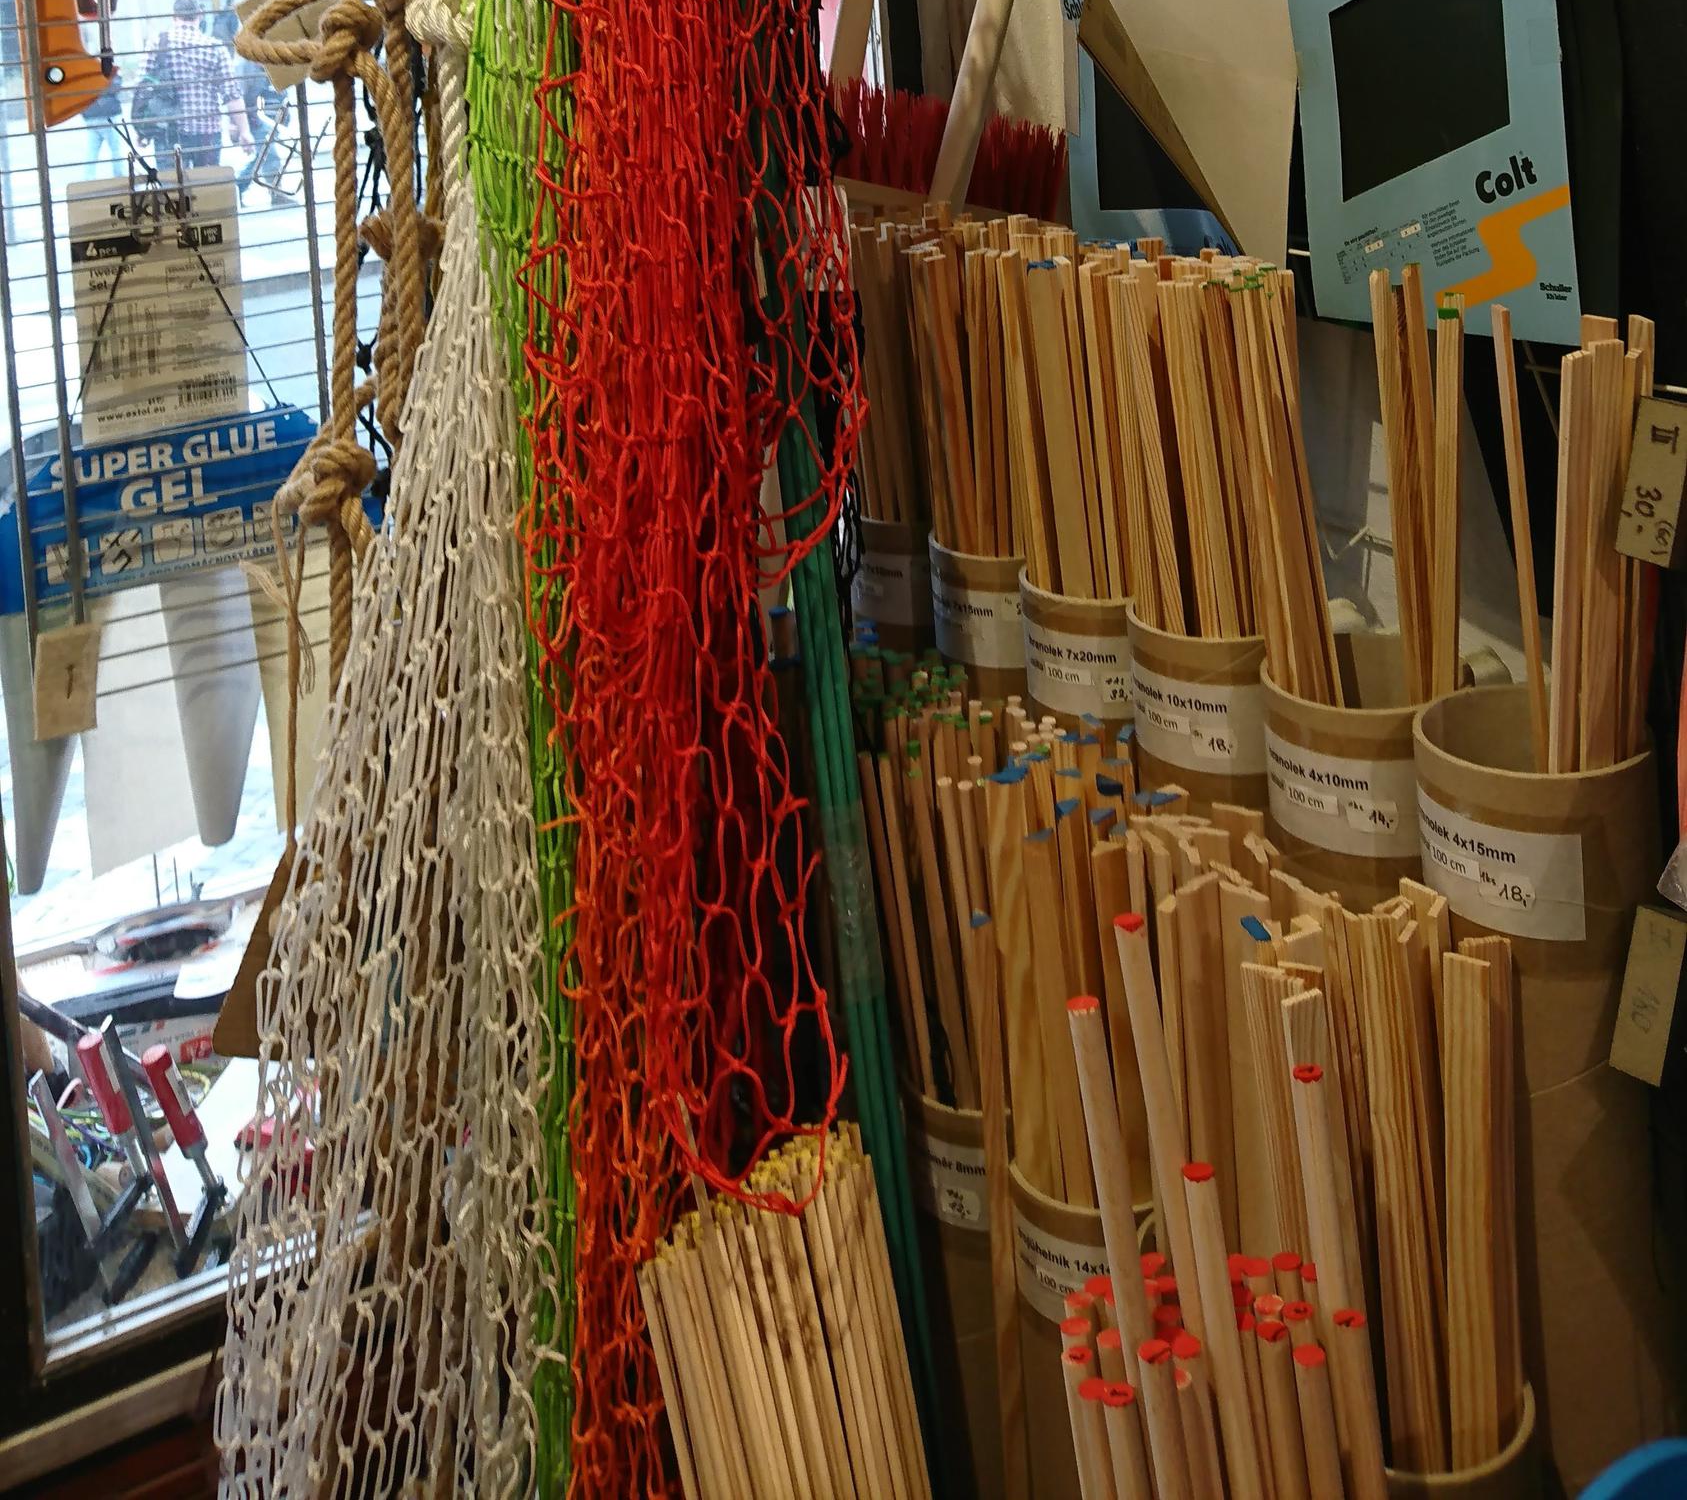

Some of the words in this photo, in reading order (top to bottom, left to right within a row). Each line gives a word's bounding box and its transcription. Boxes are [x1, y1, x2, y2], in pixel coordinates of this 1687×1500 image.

[1475, 155, 1538, 204] Colt
[49, 441, 174, 491] SUPER
[182, 420, 278, 464] GLUE
[120, 466, 219, 518] GEL
[1066, 648, 1118, 665] 7x20mm
[1048, 666, 1063, 680] 100
[1064, 673, 1080, 683] cm
[1167, 693, 1228, 714] 10x10mm
[1148, 709, 1162, 725] 100
[1163, 718, 1179, 730] cm
[1308, 768, 1369, 791] 4x10mm
[1287, 786, 1306, 803] 100
[1308, 797, 1325, 810] cm
[1417, 803, 1450, 843] nolek
[1453, 833, 1516, 864] 4x15mm
[1431, 847, 1448, 866] 100
[1450, 859, 1466, 875] cm
[1038, 1271, 1057, 1290] 100
